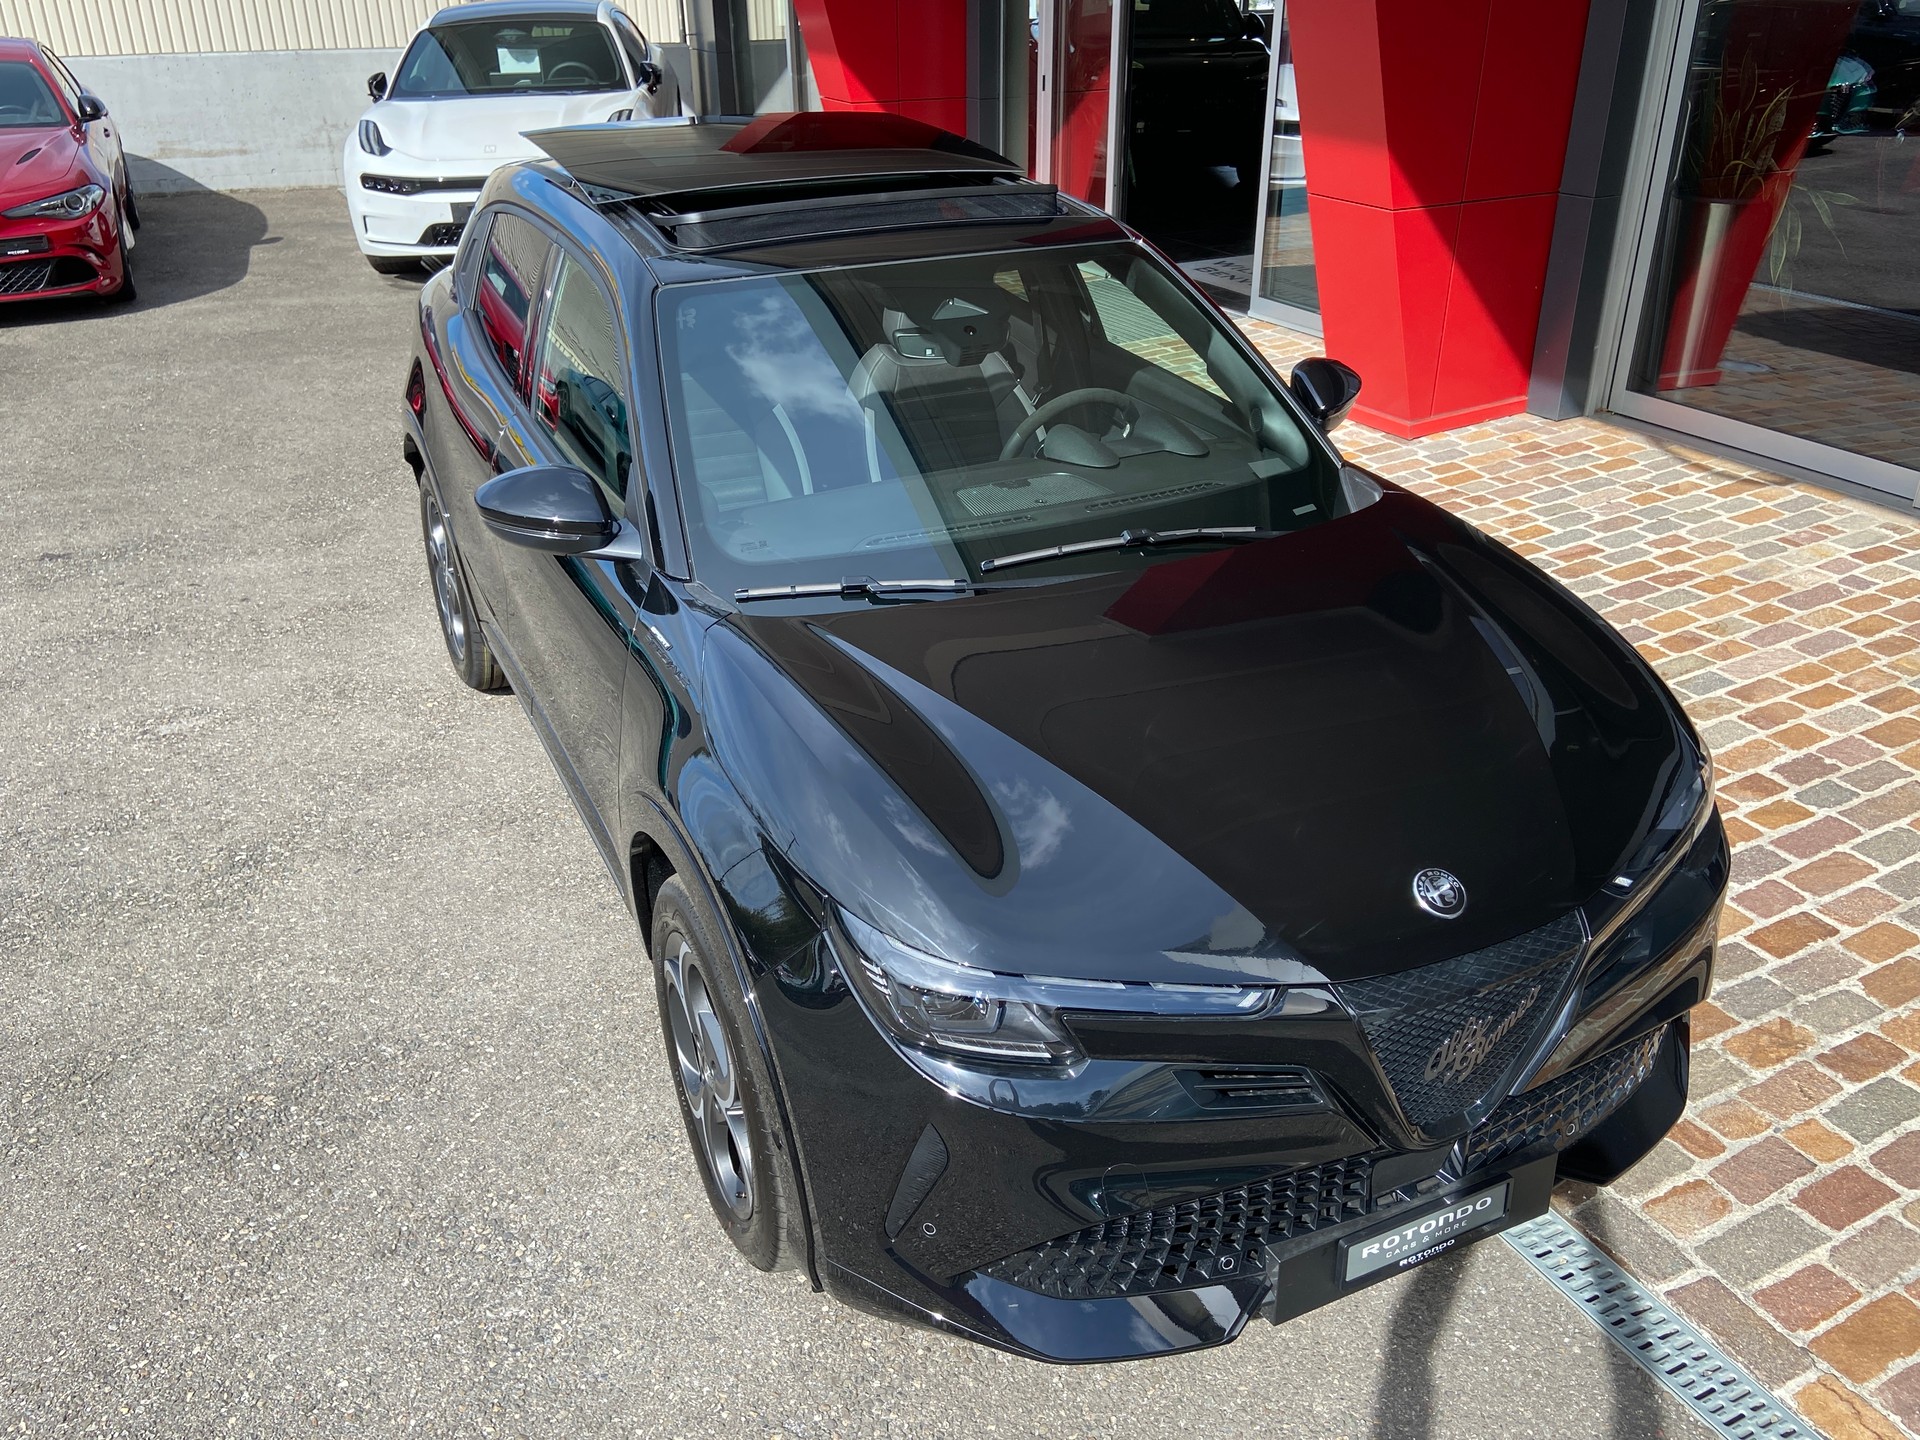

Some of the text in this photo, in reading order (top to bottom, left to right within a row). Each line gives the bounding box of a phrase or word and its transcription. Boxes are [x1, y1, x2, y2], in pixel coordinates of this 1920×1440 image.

[1361, 1196, 1492, 1259] ROTONDO
[1385, 1241, 1417, 1259] CARS
[1422, 1235, 1430, 1243] &
[1435, 1220, 1468, 1238] MORE
[1399, 1239, 1455, 1267] ROTONDO
